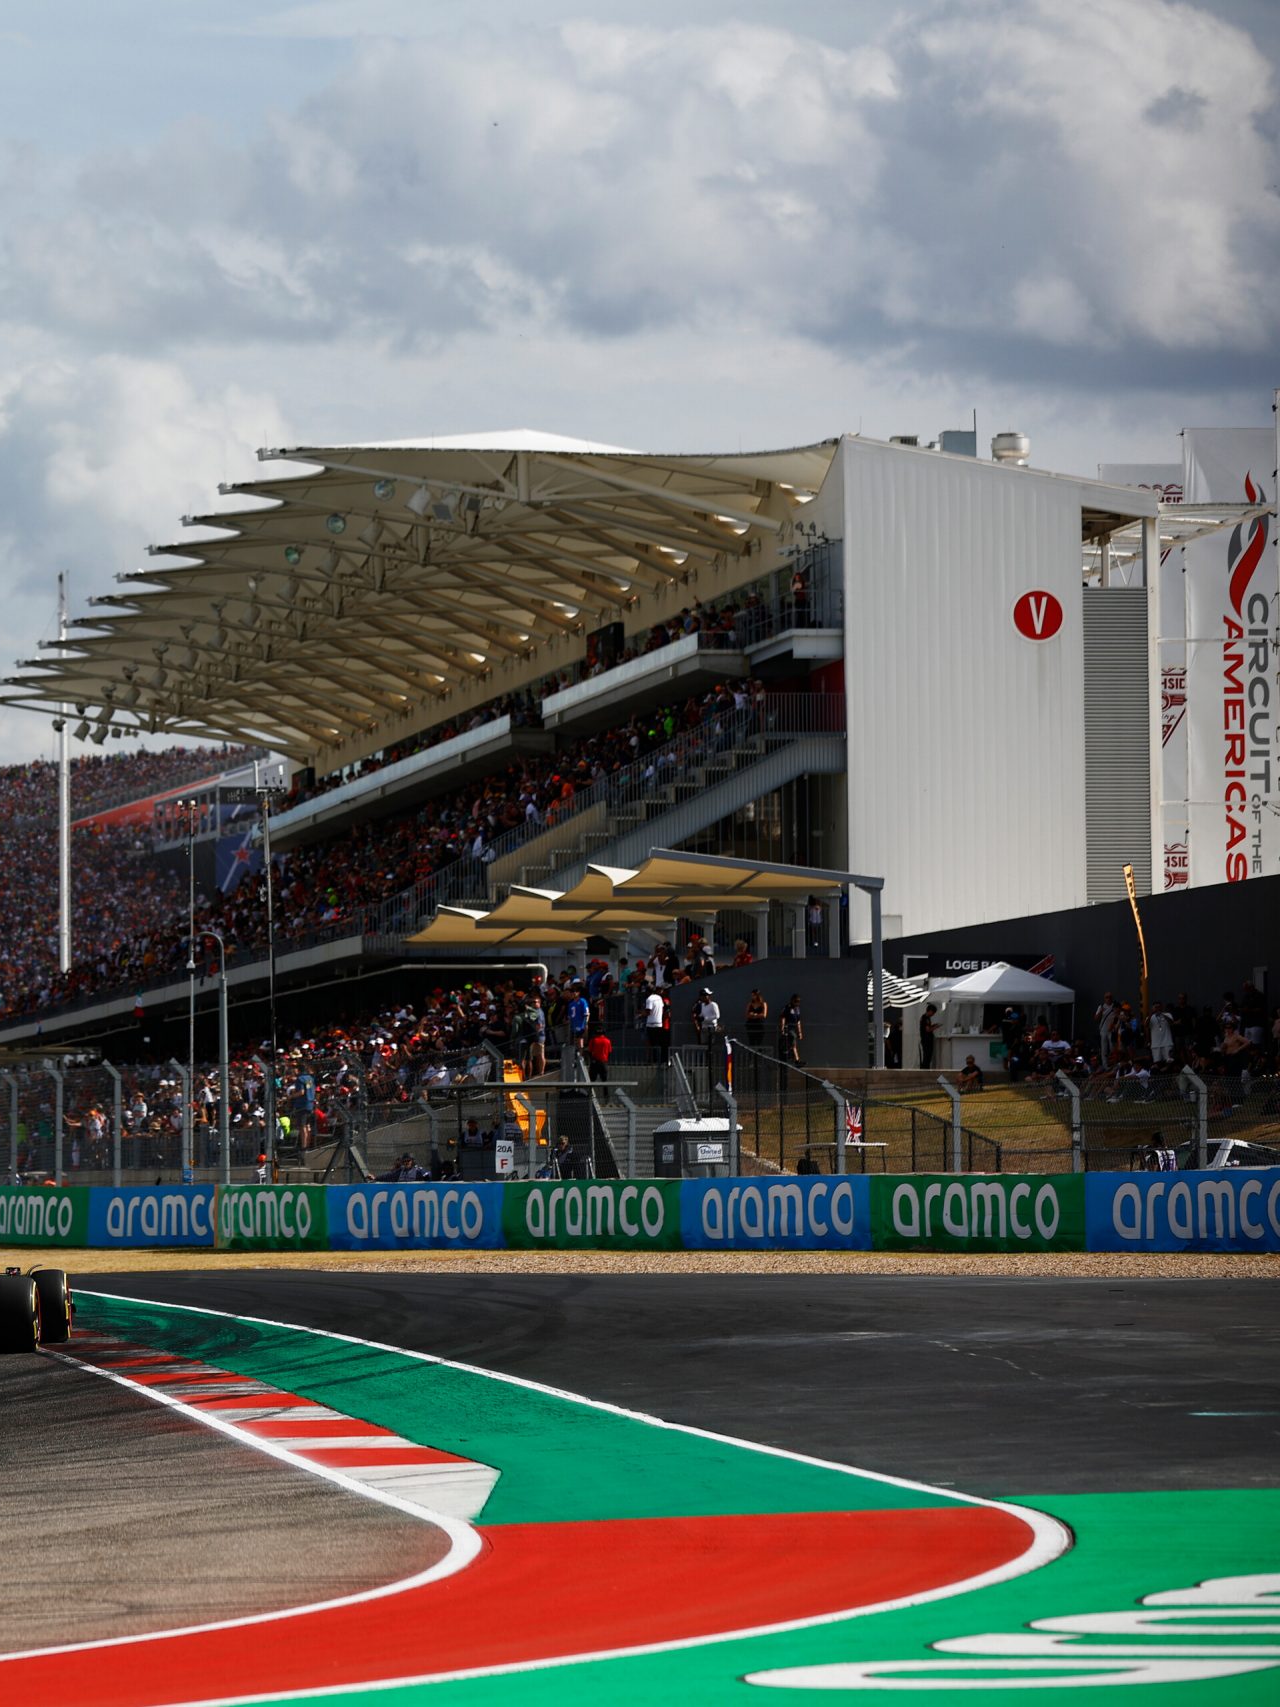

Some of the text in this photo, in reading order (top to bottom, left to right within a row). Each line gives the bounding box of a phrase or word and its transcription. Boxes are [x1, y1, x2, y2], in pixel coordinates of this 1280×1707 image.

[1028, 596, 1048, 635] V
[1223, 614, 1248, 883] AMERICAS
[1247, 592, 1271, 874] CIRCUIT OF THE
[945, 960, 979, 971] LOGE
[496, 1145, 513, 1154] 20A
[500, 1158, 509, 1170] F
[221, 1190, 312, 1239] aramco
[346, 1189, 484, 1240] aramco
[525, 1184, 665, 1240] aramco
[701, 1181, 855, 1239] aramco
[892, 1181, 1060, 1241] aramco
